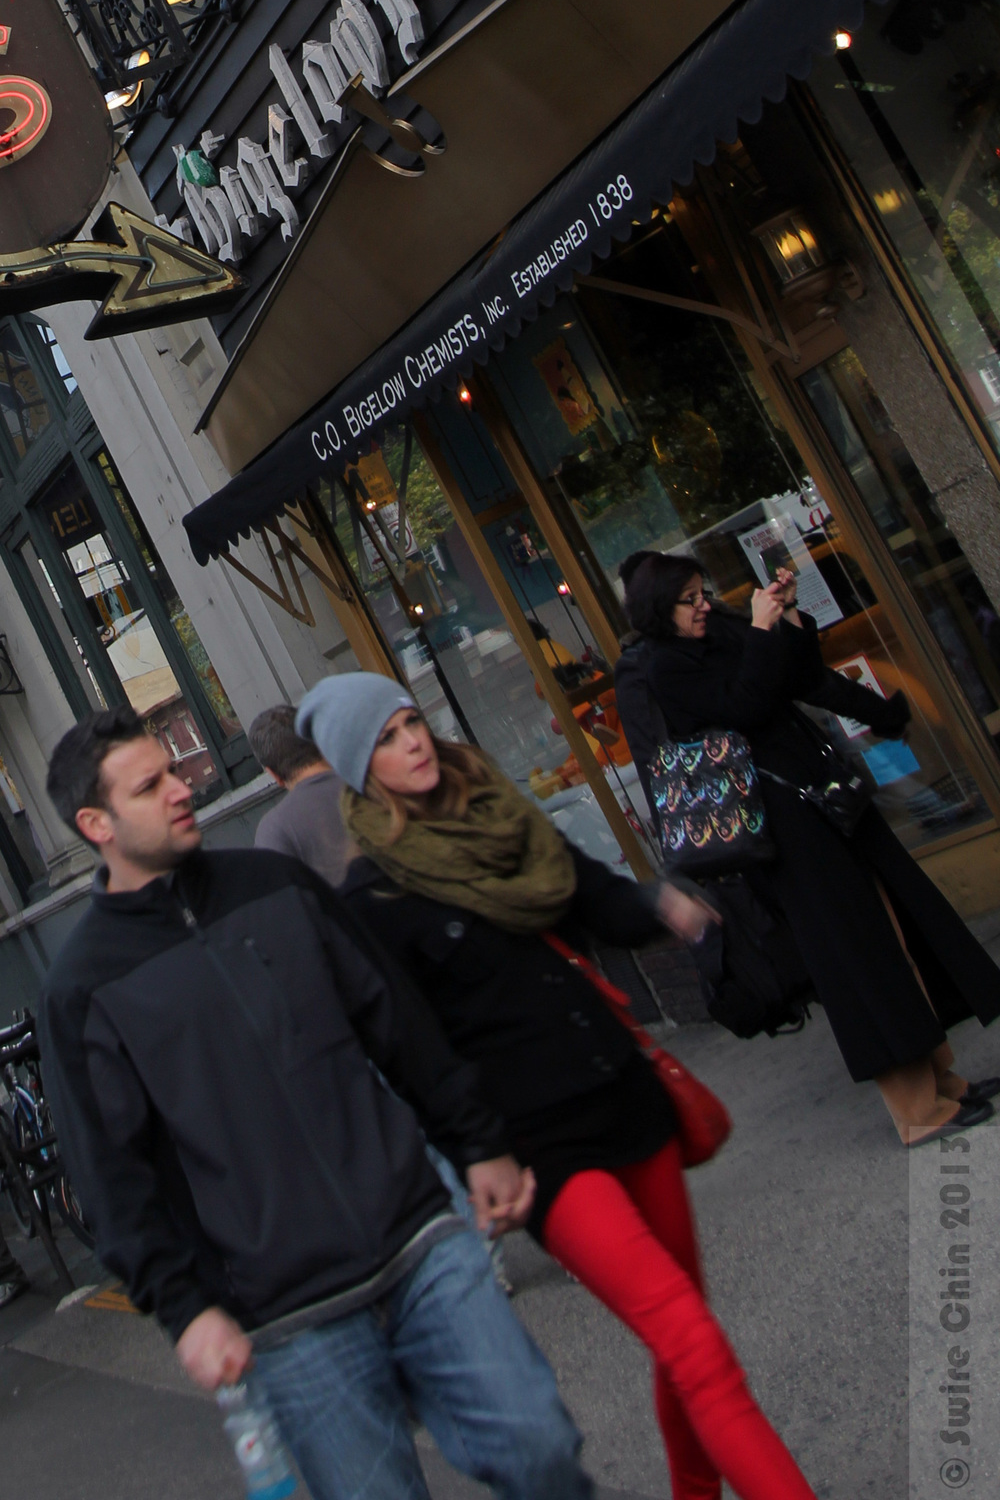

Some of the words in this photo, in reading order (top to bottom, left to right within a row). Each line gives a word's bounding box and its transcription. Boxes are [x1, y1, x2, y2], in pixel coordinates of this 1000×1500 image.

[311, 419, 348, 461] C.O.
[342, 372, 408, 438] BIGELOW
[403, 312, 487, 389] CHEMISTS,
[481, 295, 511, 327] INC.
[510, 218, 588, 299] ESTABLISHED
[588, 173, 634, 227] 1838
